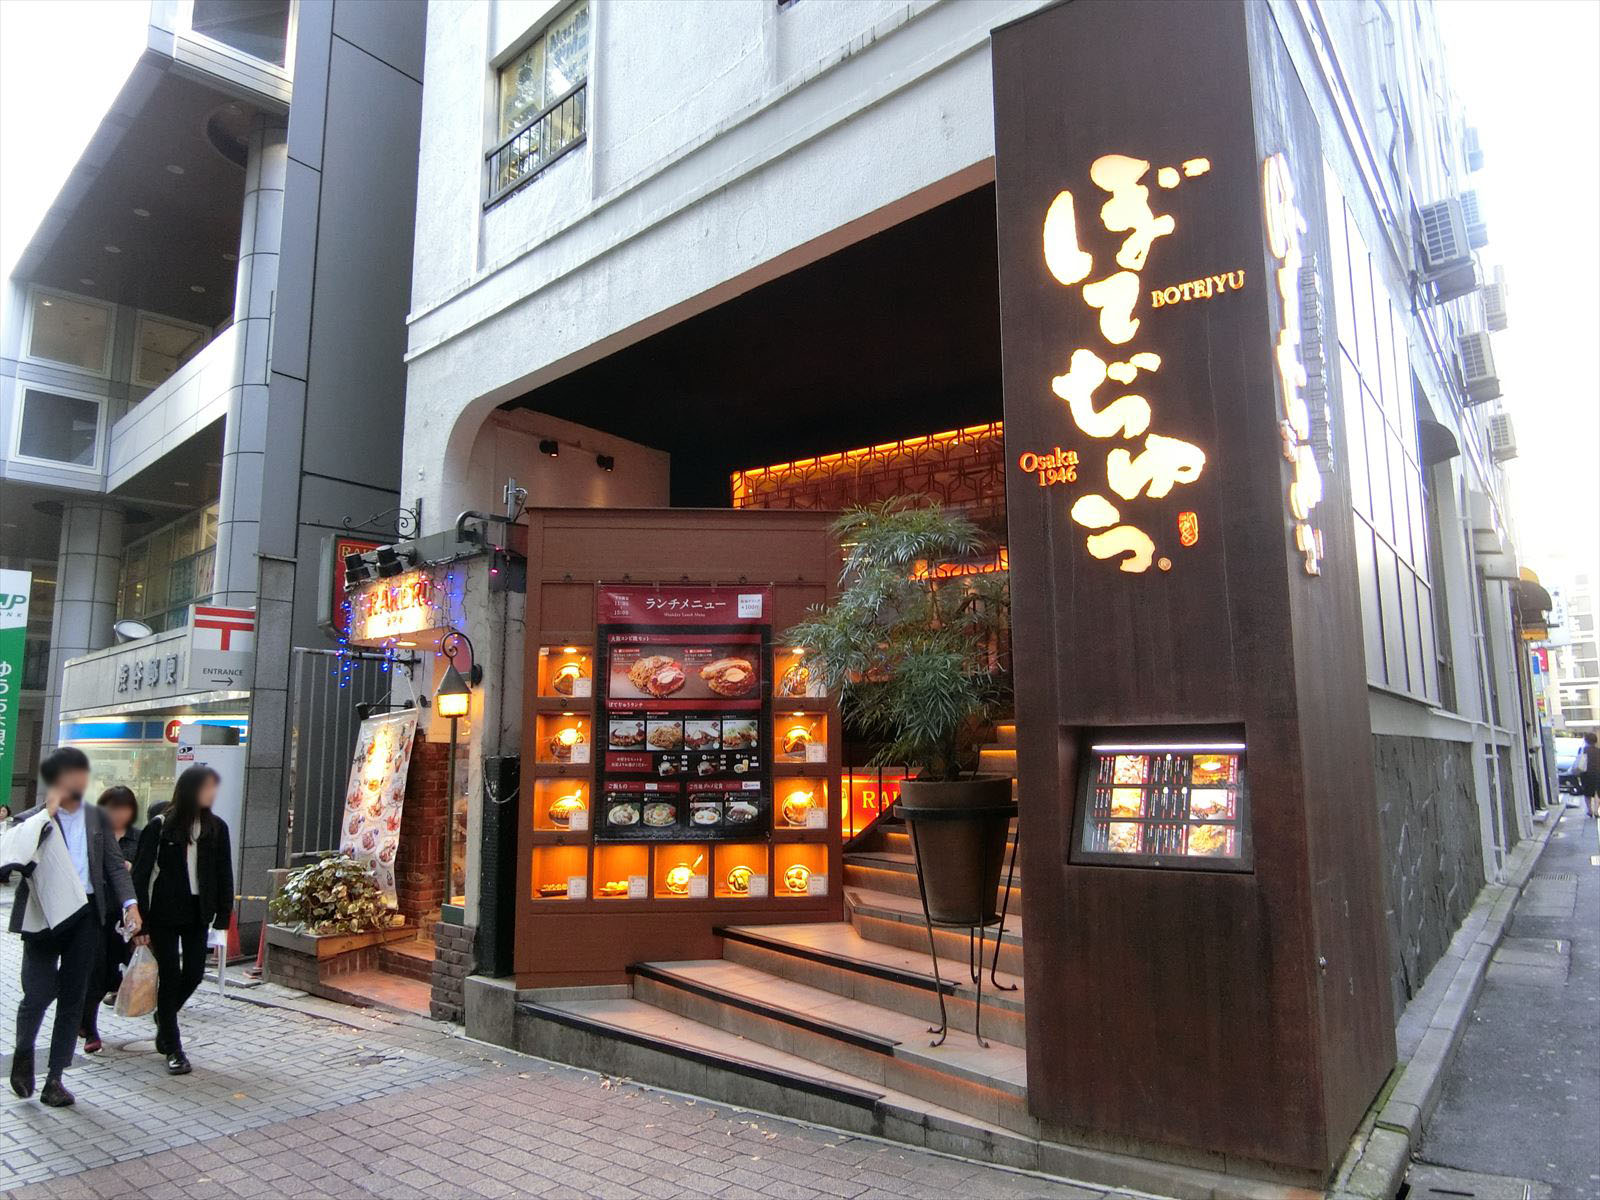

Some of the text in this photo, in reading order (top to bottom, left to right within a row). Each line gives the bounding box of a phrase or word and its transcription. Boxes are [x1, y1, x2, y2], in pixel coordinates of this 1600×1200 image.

[1151, 269, 1246, 308] BOTEJYU
[1043, 154, 1212, 574] ぼてぢゅう
[1019, 447, 1079, 473] Osaka
[1038, 465, 1078, 487] 1946
[646, 598, 727, 610] ランチメニュー
[202, 667, 244, 677] ENTRANCE
